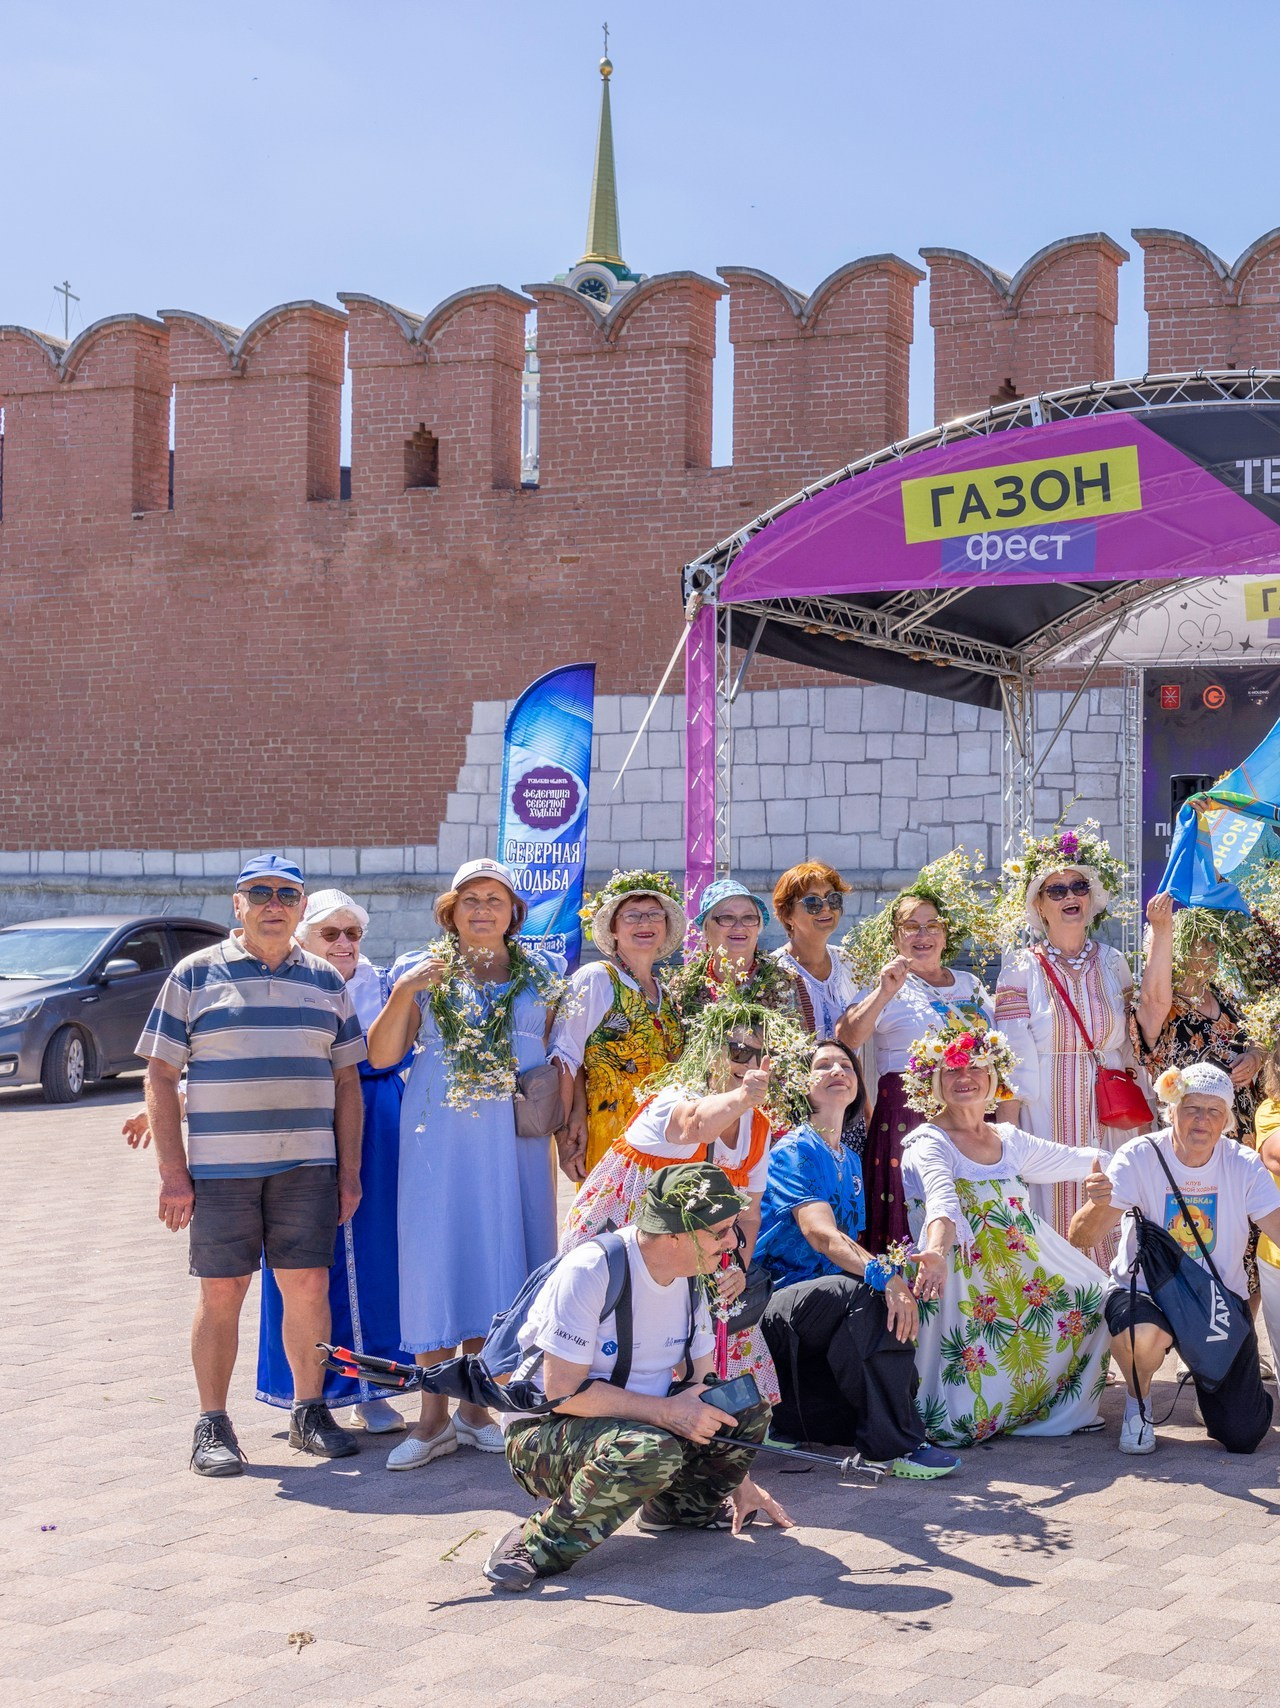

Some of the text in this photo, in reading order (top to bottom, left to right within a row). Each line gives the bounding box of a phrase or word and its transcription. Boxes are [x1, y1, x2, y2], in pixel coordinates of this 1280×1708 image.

[930, 462, 1112, 528] ГАЗОН
[965, 532, 1071, 570] фест
[523, 789, 571, 799] ФЕДЕРАЦИЯ
[526, 798, 566, 808] СЕВЕРНОЙ
[529, 807, 562, 818] ХОДЬБЫ
[506, 839, 581, 864] СЕВЕРНАЯ
[513, 868, 570, 895] ХОДЬБА
[1205, 1279, 1231, 1343] VAN
